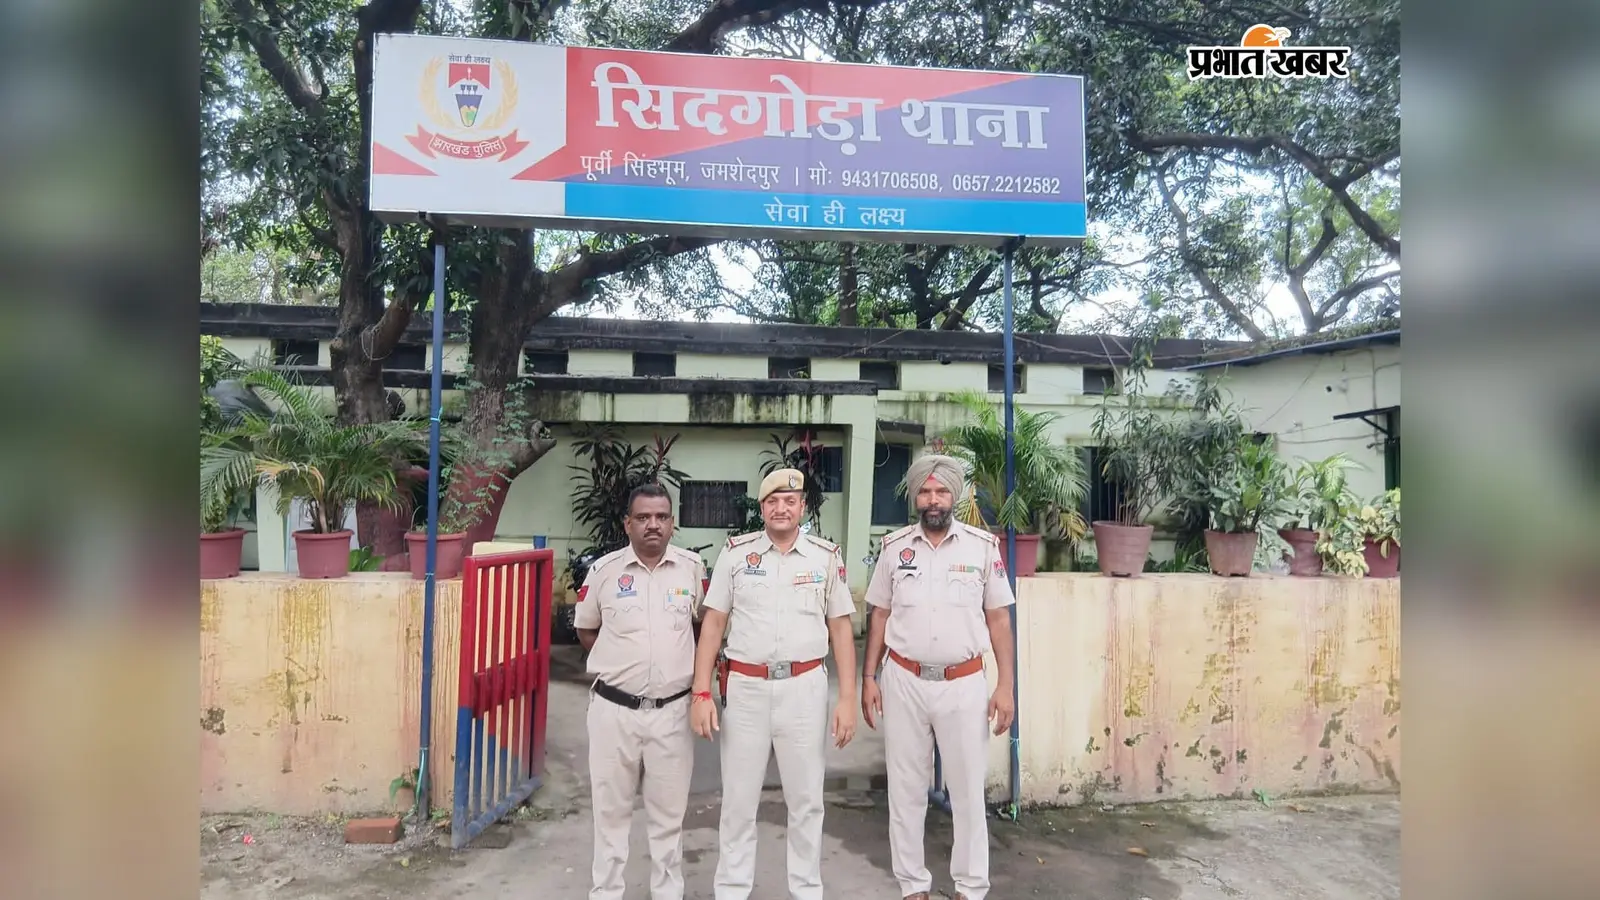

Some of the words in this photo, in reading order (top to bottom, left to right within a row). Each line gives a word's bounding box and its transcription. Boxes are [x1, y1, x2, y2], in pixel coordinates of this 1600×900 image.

[590, 61, 884, 156] सिदगोड़ा
[900, 98, 1050, 150] थाना
[431, 137, 470, 156] झारखंड
[472, 138, 502, 158] पुलिस
[580, 149, 613, 182] पूर्वी
[623, 151, 690, 186] सिंहभूम,
[700, 156, 781, 190] जमशेदपुर
[841, 169, 943, 193] 9431706508,
[952, 174, 1061, 195] 0657.2212582
[763, 196, 809, 223] सेवा
[820, 200, 846, 225] ही
[858, 206, 906, 227] लक्ष्य
